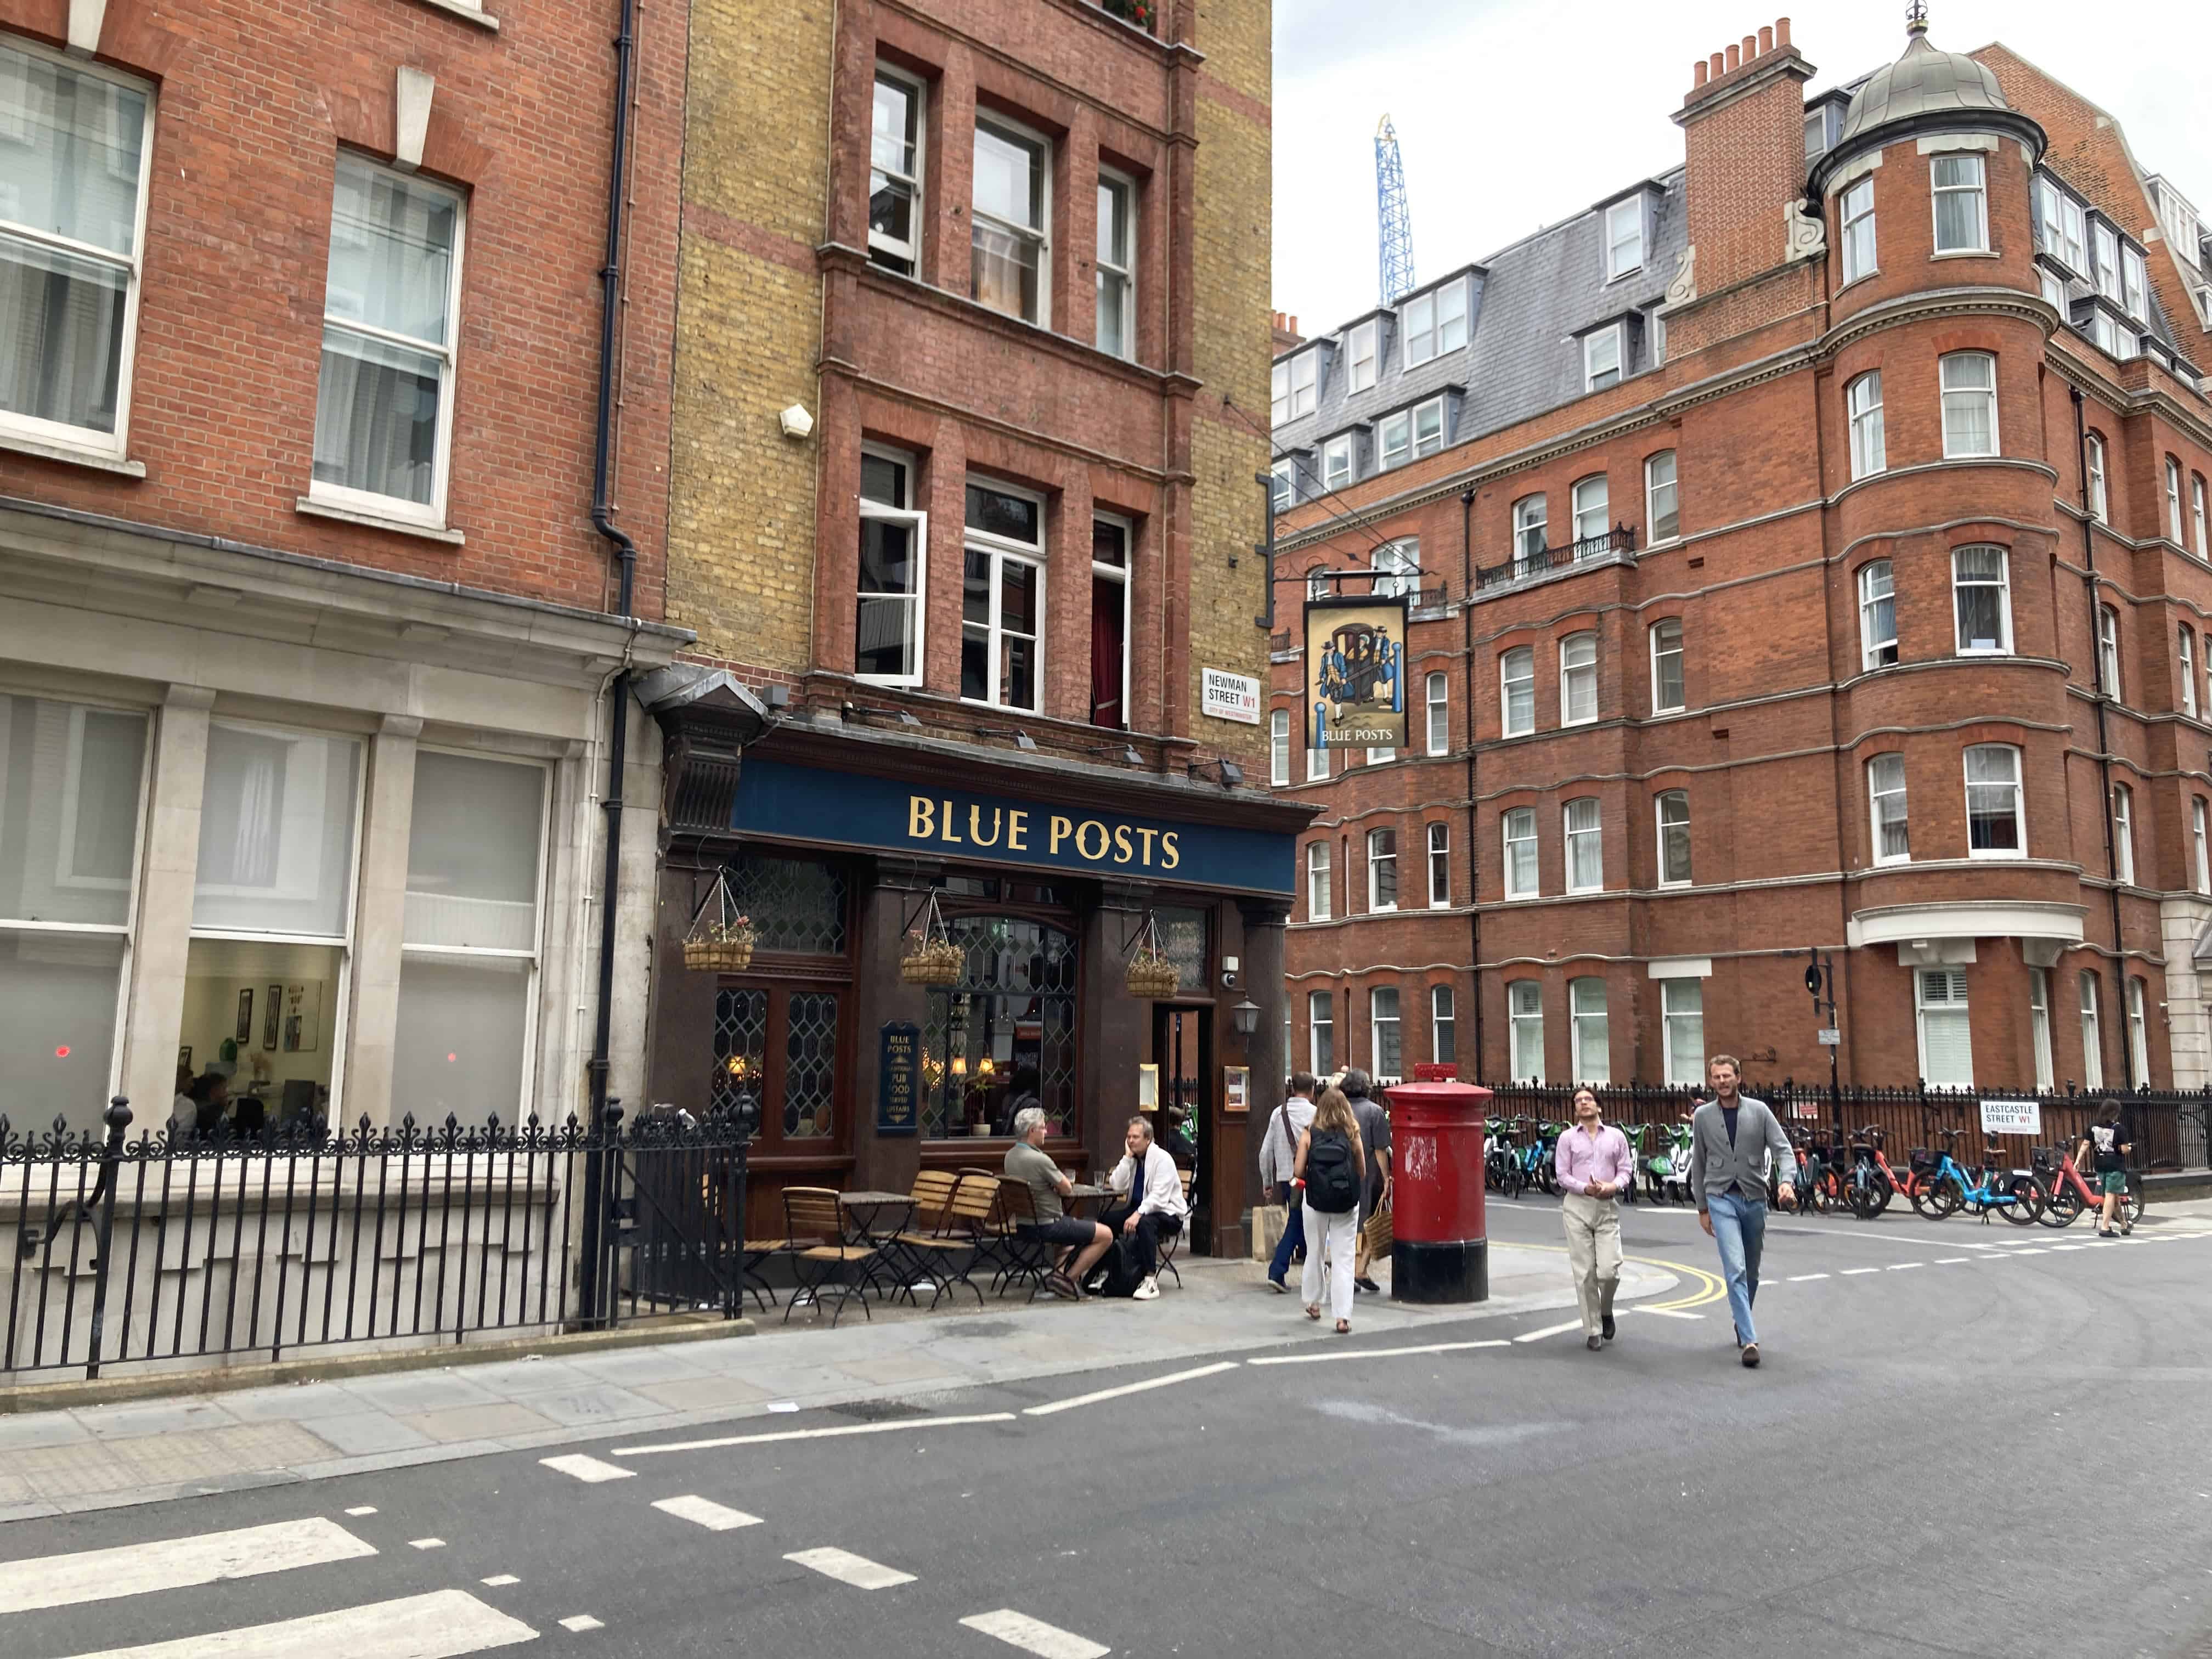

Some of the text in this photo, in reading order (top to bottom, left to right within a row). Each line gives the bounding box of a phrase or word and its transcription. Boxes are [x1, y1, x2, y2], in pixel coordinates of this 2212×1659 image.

[1209, 674, 1246, 692] NEWMAN
[1209, 689, 1255, 708] STREET W1
[1322, 729, 1393, 741] BLUE POSTS
[909, 795, 1180, 870] BLUE POSTS
[890, 1035, 910, 1043] BLUE
[887, 1045, 911, 1054] POSTS
[892, 1073, 907, 1084] PUB
[888, 1084, 910, 1094] OOD
[1985, 1105, 2032, 1114] EASTCASTLE
[1987, 1114, 2030, 1124] STREET W1
